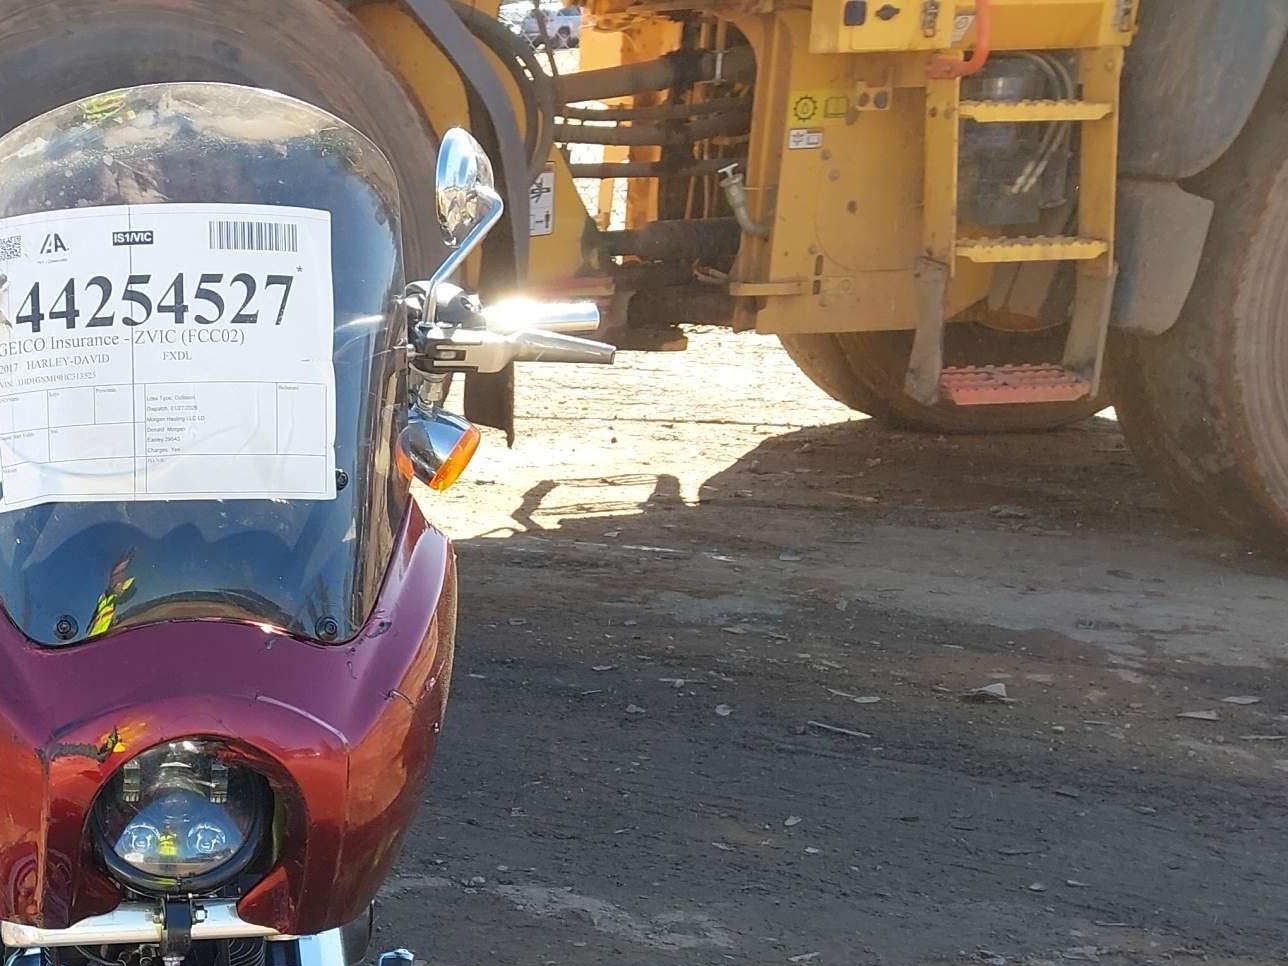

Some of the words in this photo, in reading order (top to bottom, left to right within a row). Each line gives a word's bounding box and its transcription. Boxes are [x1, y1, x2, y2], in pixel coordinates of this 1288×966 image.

[113, 232, 153, 244] IS1/VIC
[15, 272, 295, 334] 44254527
[51, 335, 120, 350] Insurance
[135, 329, 177, 344] ZVIC
[181, 328, 245, 346] (FCC02)
[0, 362, 19, 375] 2017
[27, 354, 110, 370] HARLEY-DAVID
[162, 350, 192, 361] FXDL
